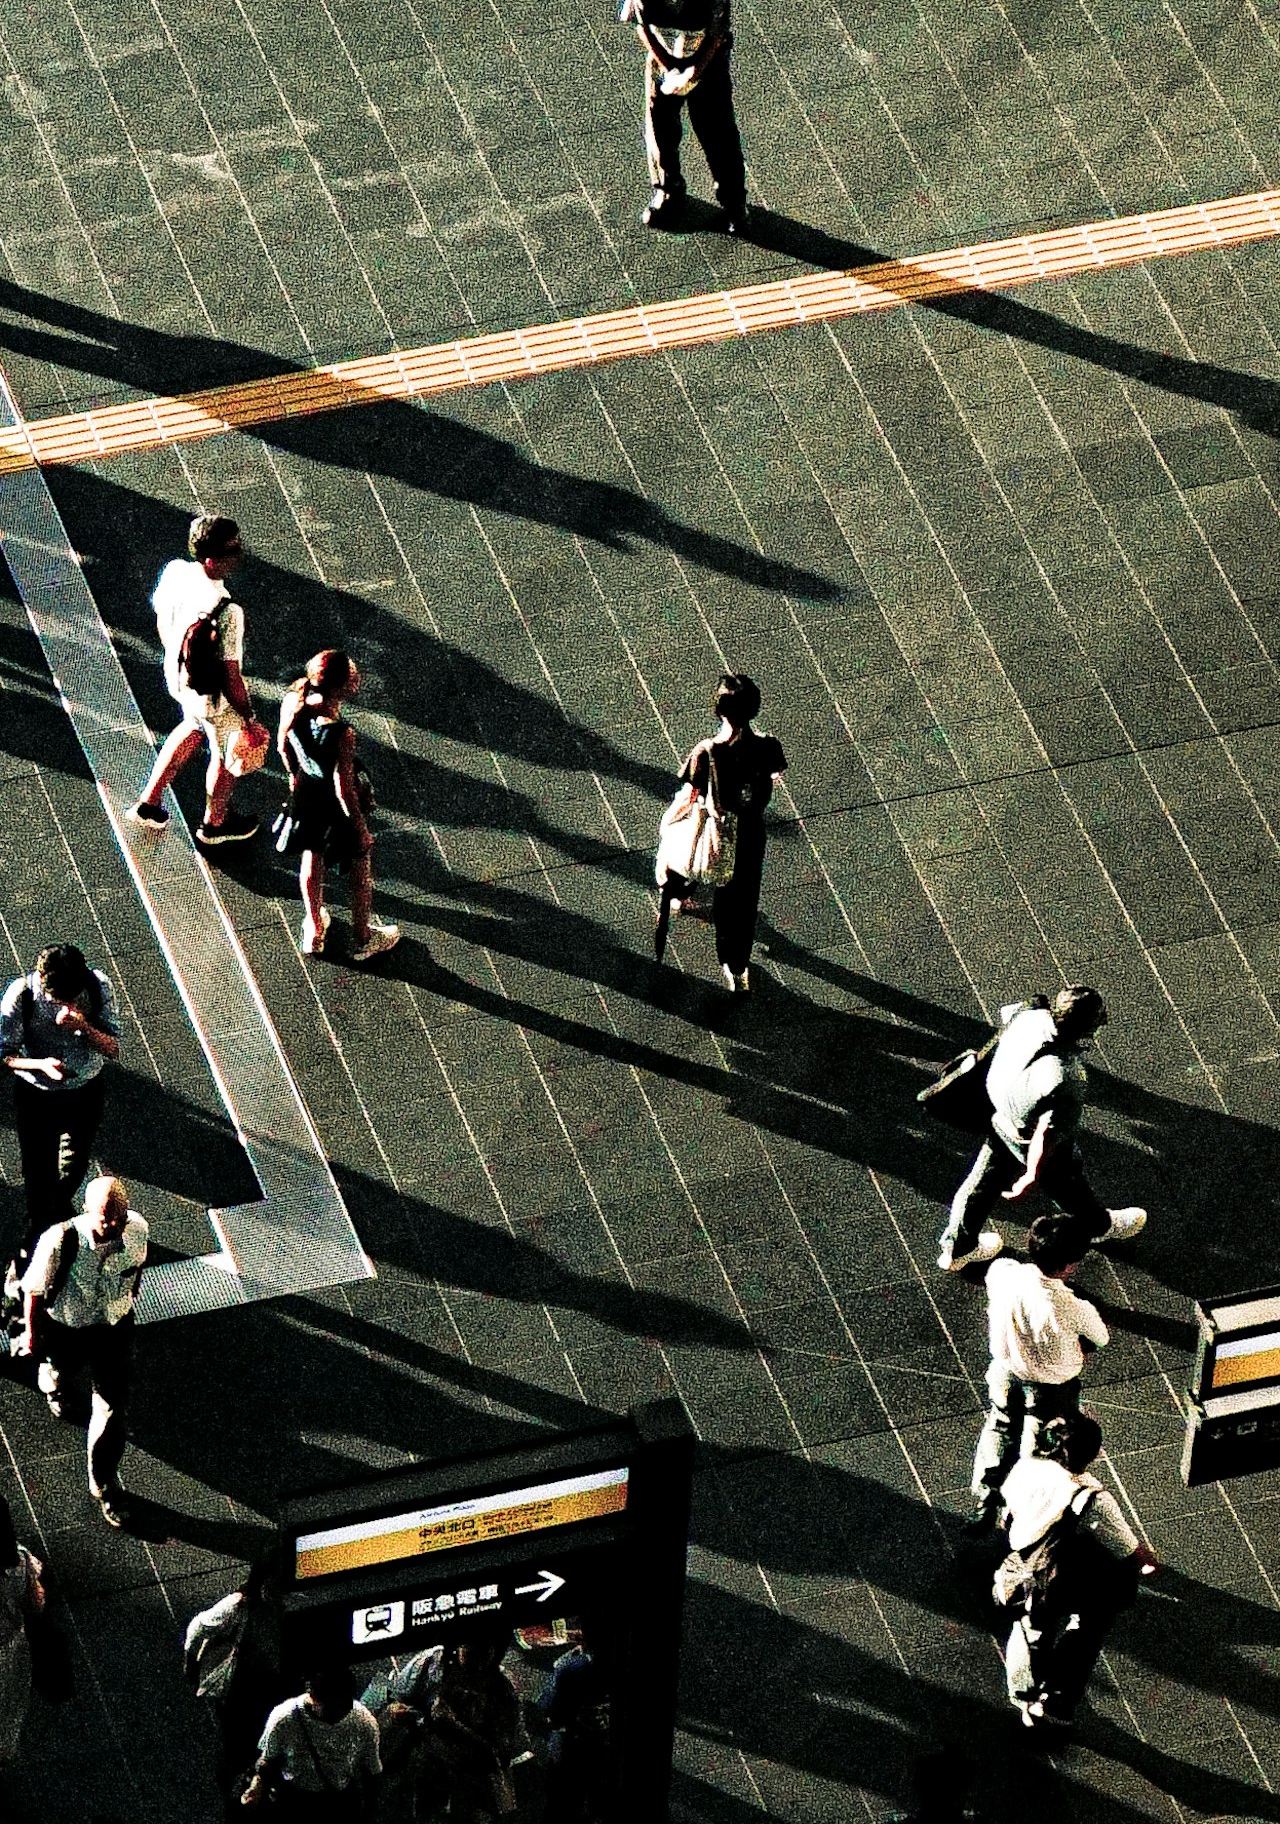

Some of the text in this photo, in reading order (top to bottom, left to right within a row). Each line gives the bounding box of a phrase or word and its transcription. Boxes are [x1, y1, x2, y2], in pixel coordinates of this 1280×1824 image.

[419, 1519, 475, 1538] 中央北口
[412, 1584, 499, 1616] 阪急電車
[459, 1601, 503, 1616] Railway
